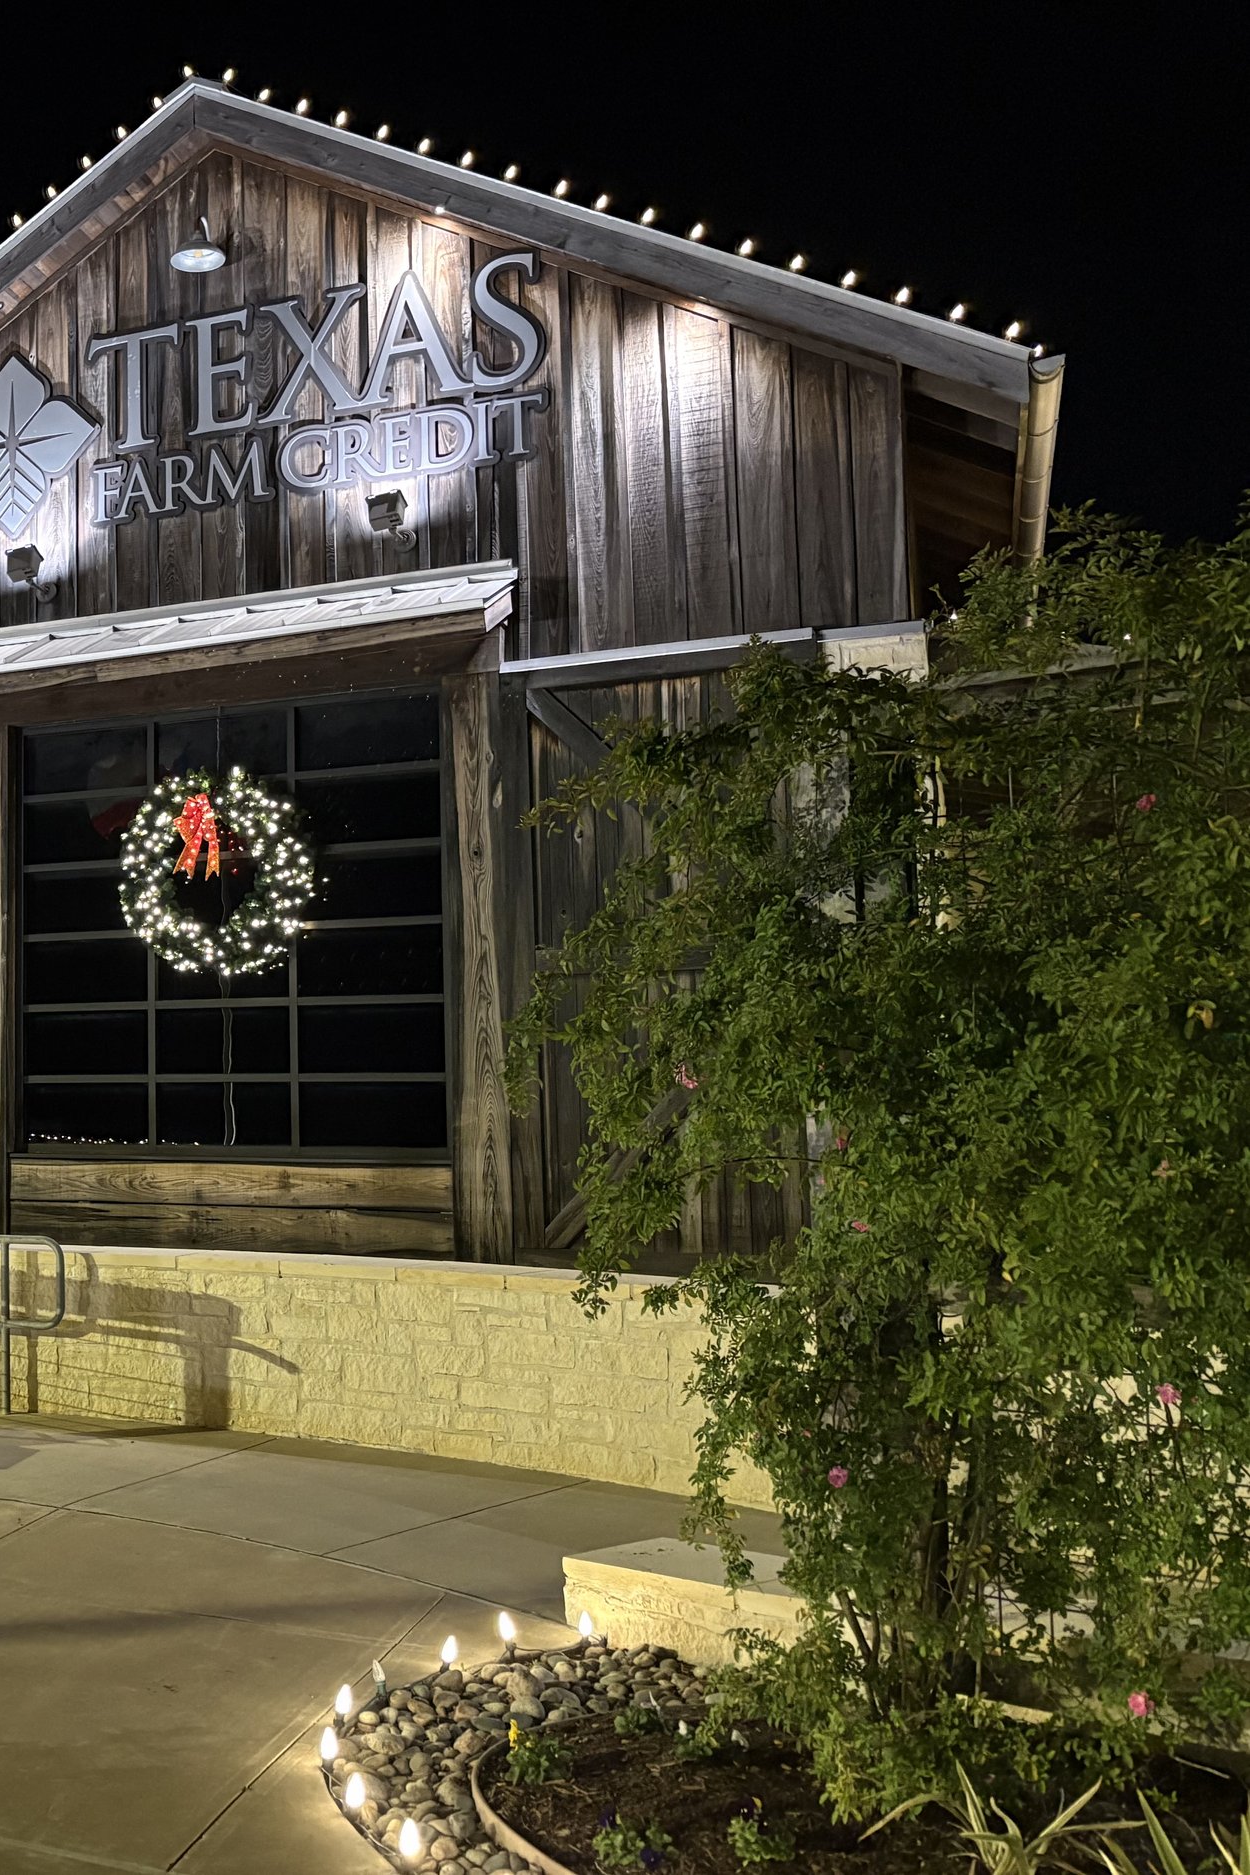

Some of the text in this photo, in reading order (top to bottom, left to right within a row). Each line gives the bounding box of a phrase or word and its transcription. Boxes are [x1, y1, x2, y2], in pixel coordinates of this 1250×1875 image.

[86, 251, 542, 450] TEXAS
[93, 393, 544, 524] FARM CREDIT
